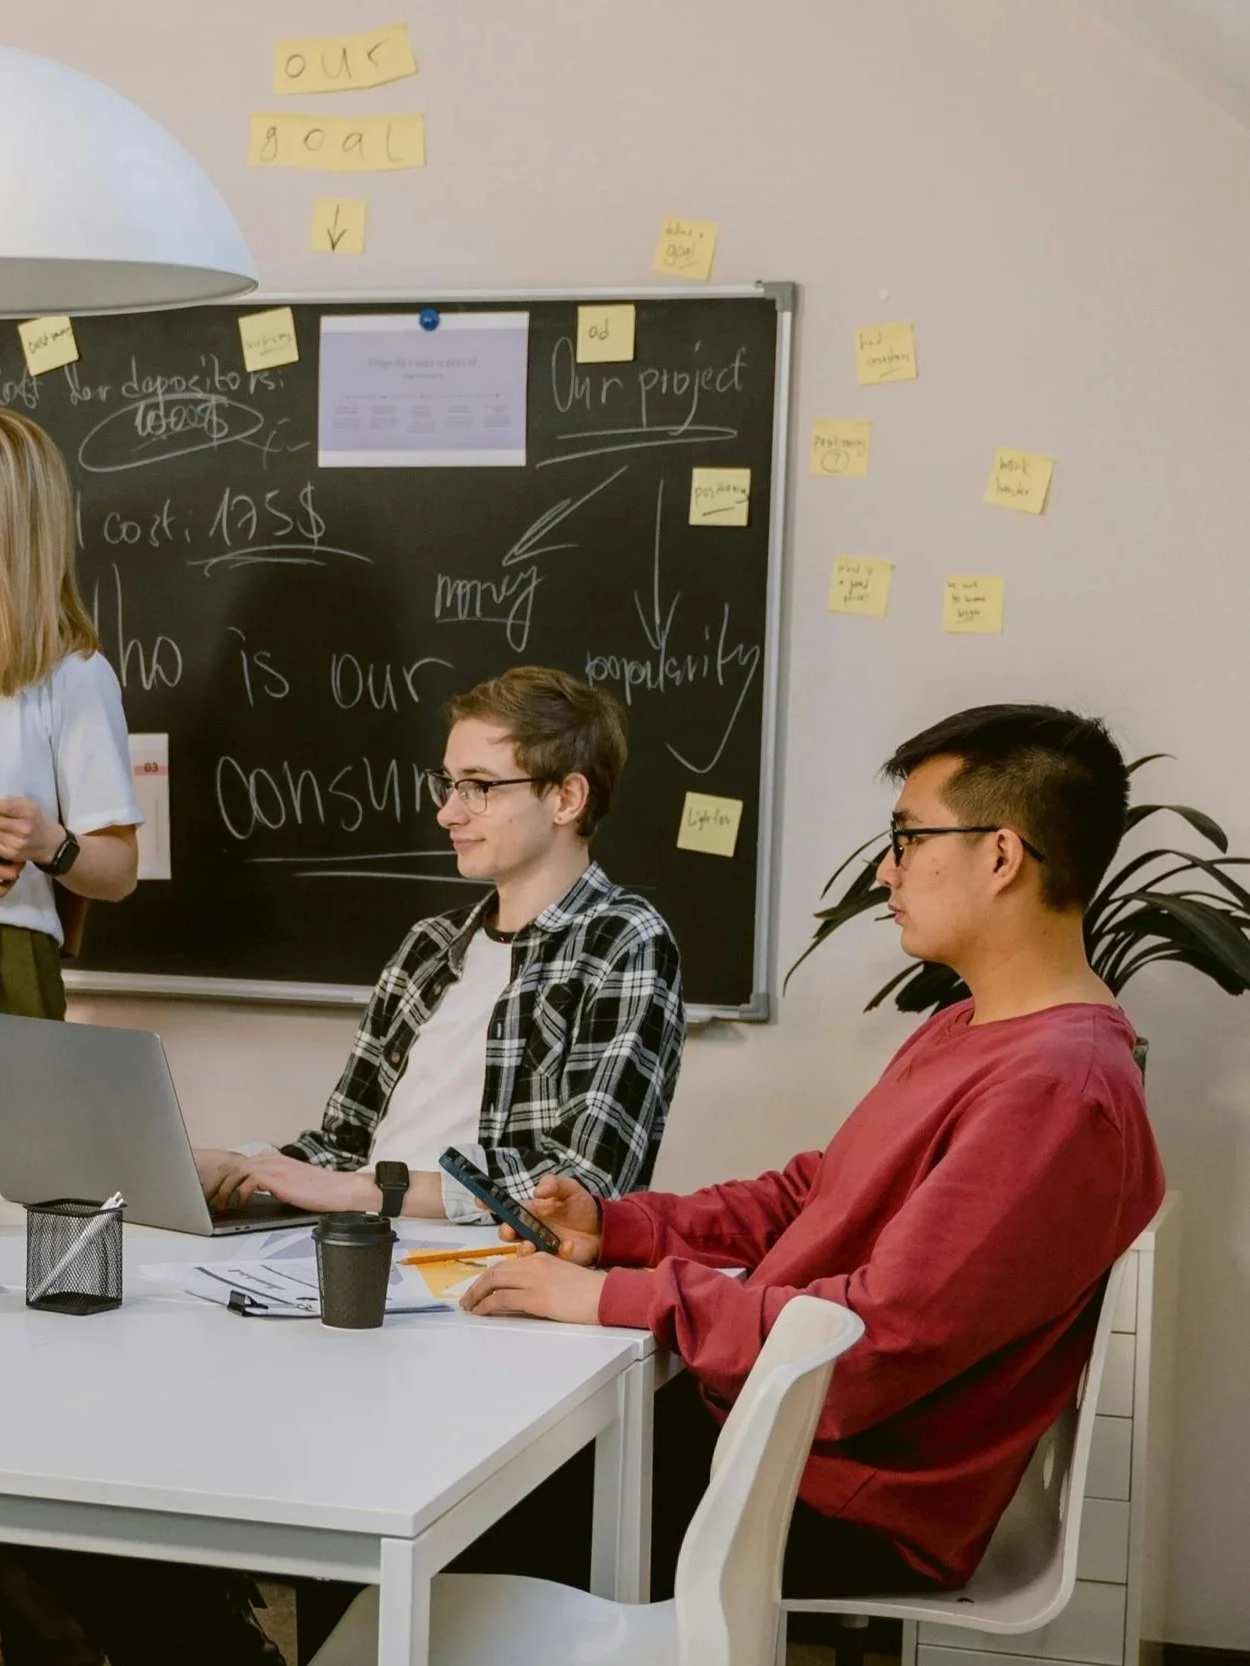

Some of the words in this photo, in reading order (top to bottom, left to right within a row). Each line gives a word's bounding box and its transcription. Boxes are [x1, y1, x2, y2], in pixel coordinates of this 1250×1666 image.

[284, 39, 391, 80] our
[259, 121, 403, 163] goal
[588, 317, 610, 341] ad
[552, 336, 624, 413] Our
[639, 340, 748, 436] project
[209, 480, 326, 552] 175$
[94, 562, 183, 690] ho
[228, 626, 290, 706] is
[331, 653, 455, 712] our
[144, 762, 159, 773] 03
